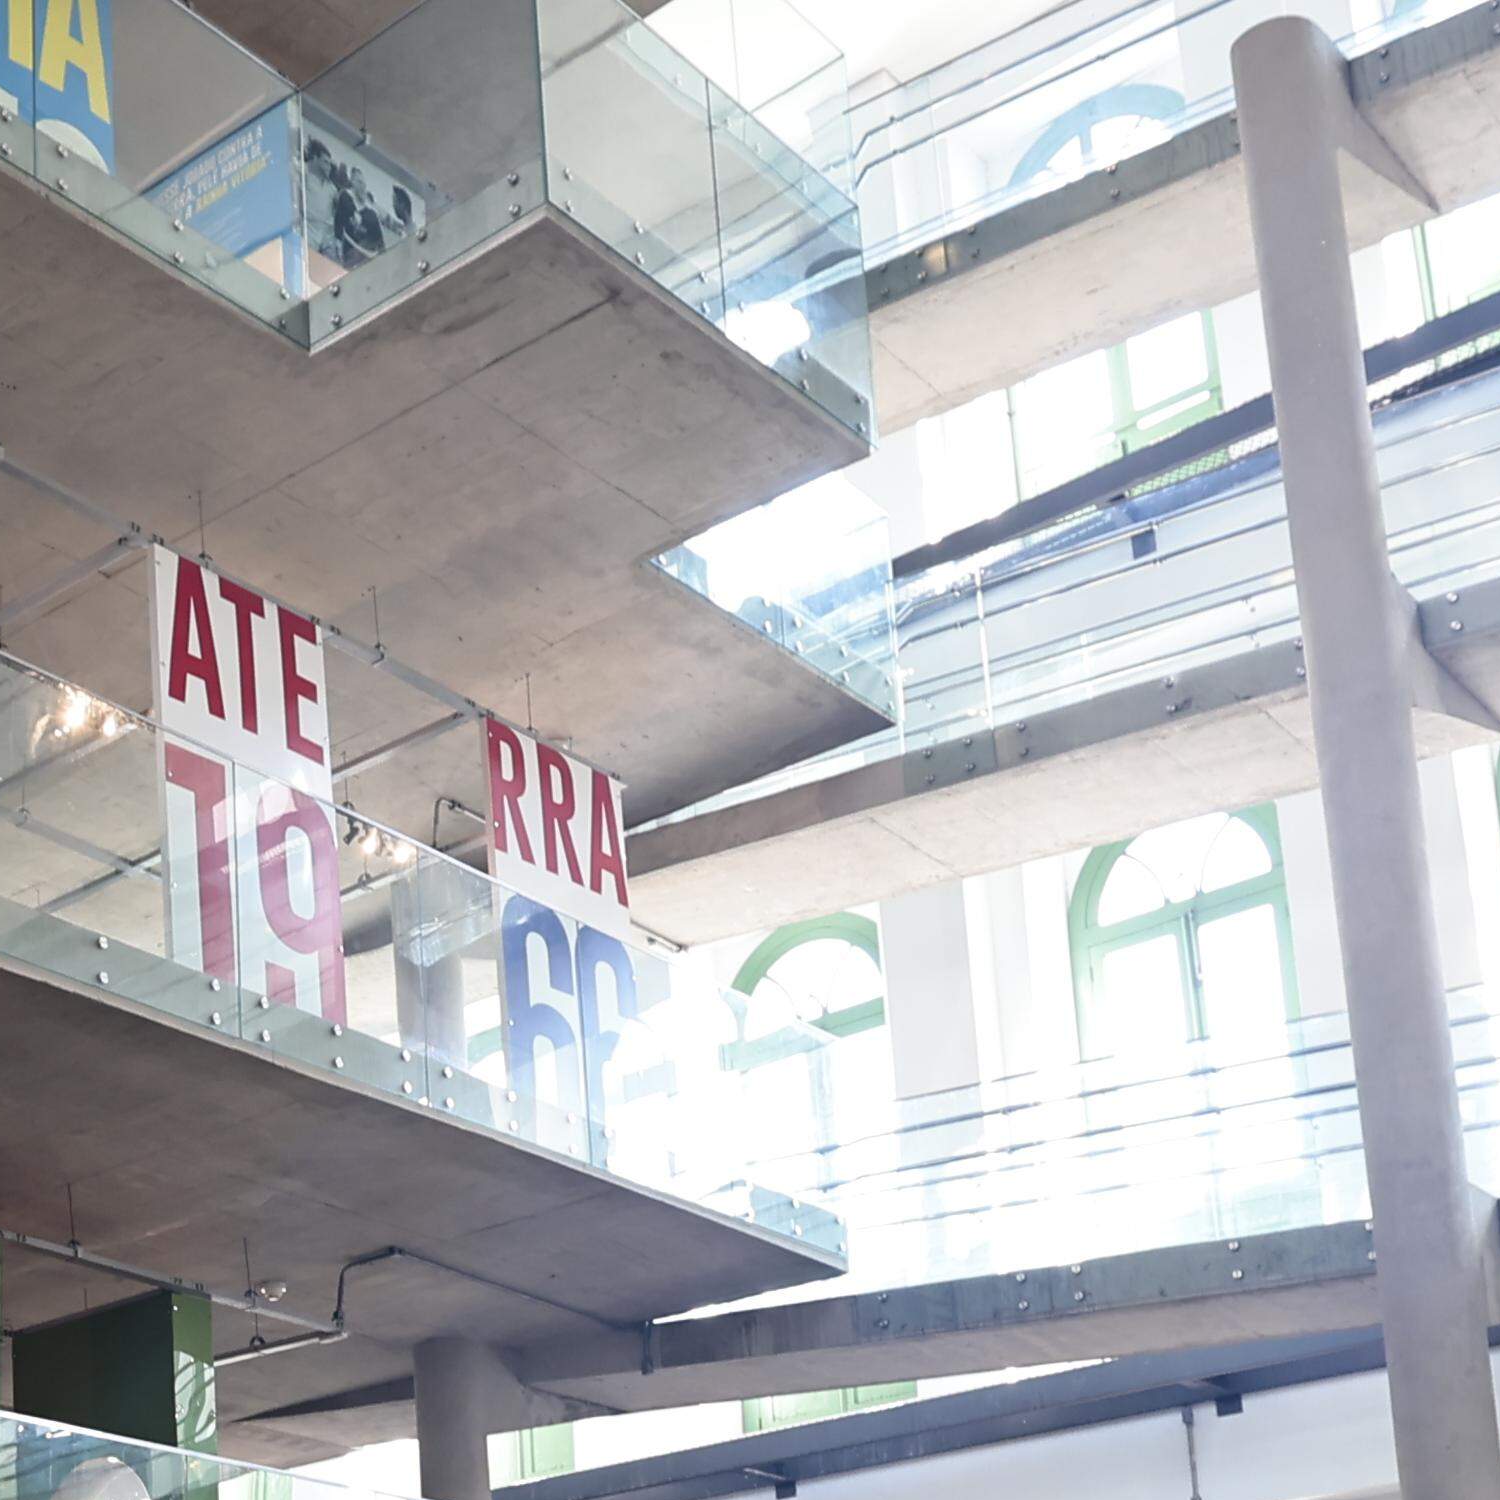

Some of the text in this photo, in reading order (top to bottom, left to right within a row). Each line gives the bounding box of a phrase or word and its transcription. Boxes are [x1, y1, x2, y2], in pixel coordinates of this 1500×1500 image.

[168, 559, 325, 766] ATE
[166, 744, 345, 1029] 19
[486, 719, 629, 908] RRA
